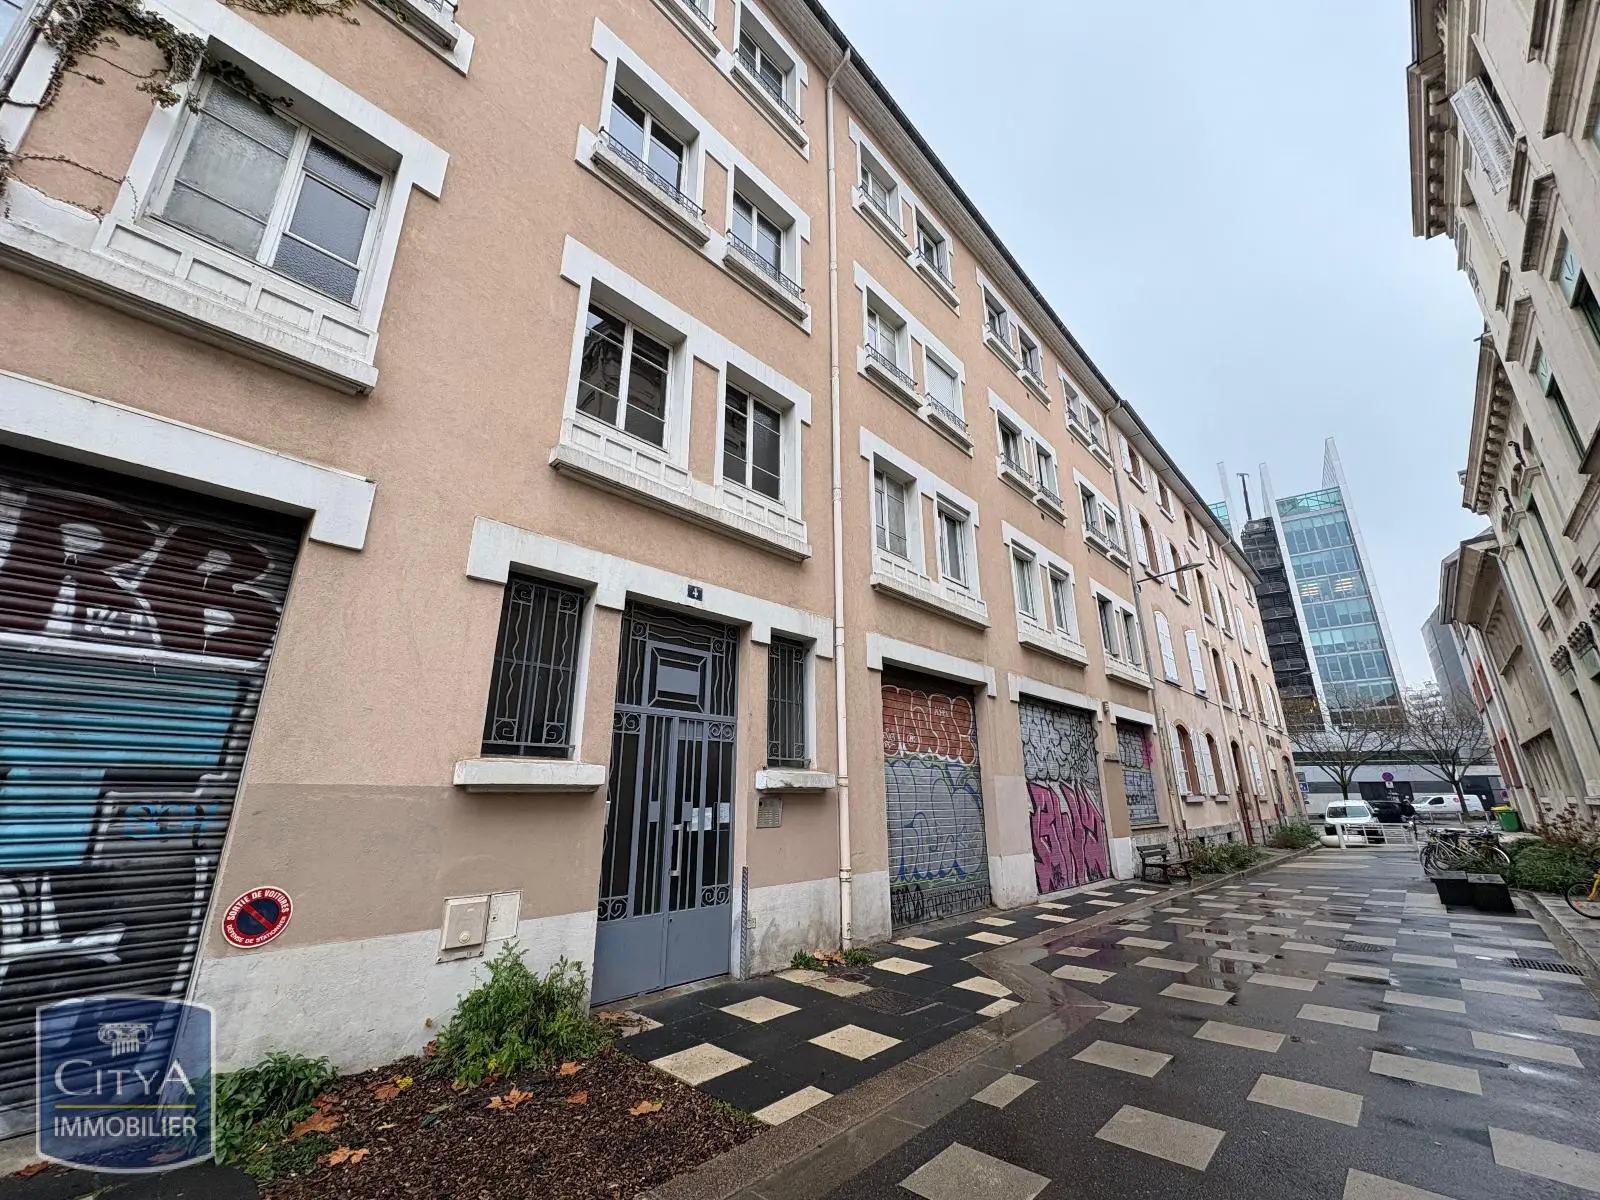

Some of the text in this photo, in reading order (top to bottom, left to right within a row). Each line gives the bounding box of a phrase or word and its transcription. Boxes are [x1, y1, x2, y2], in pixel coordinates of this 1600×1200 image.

[227, 889, 290, 920] SORTIE DE VOITURES
[256, 916, 287, 943] STATIONNER
